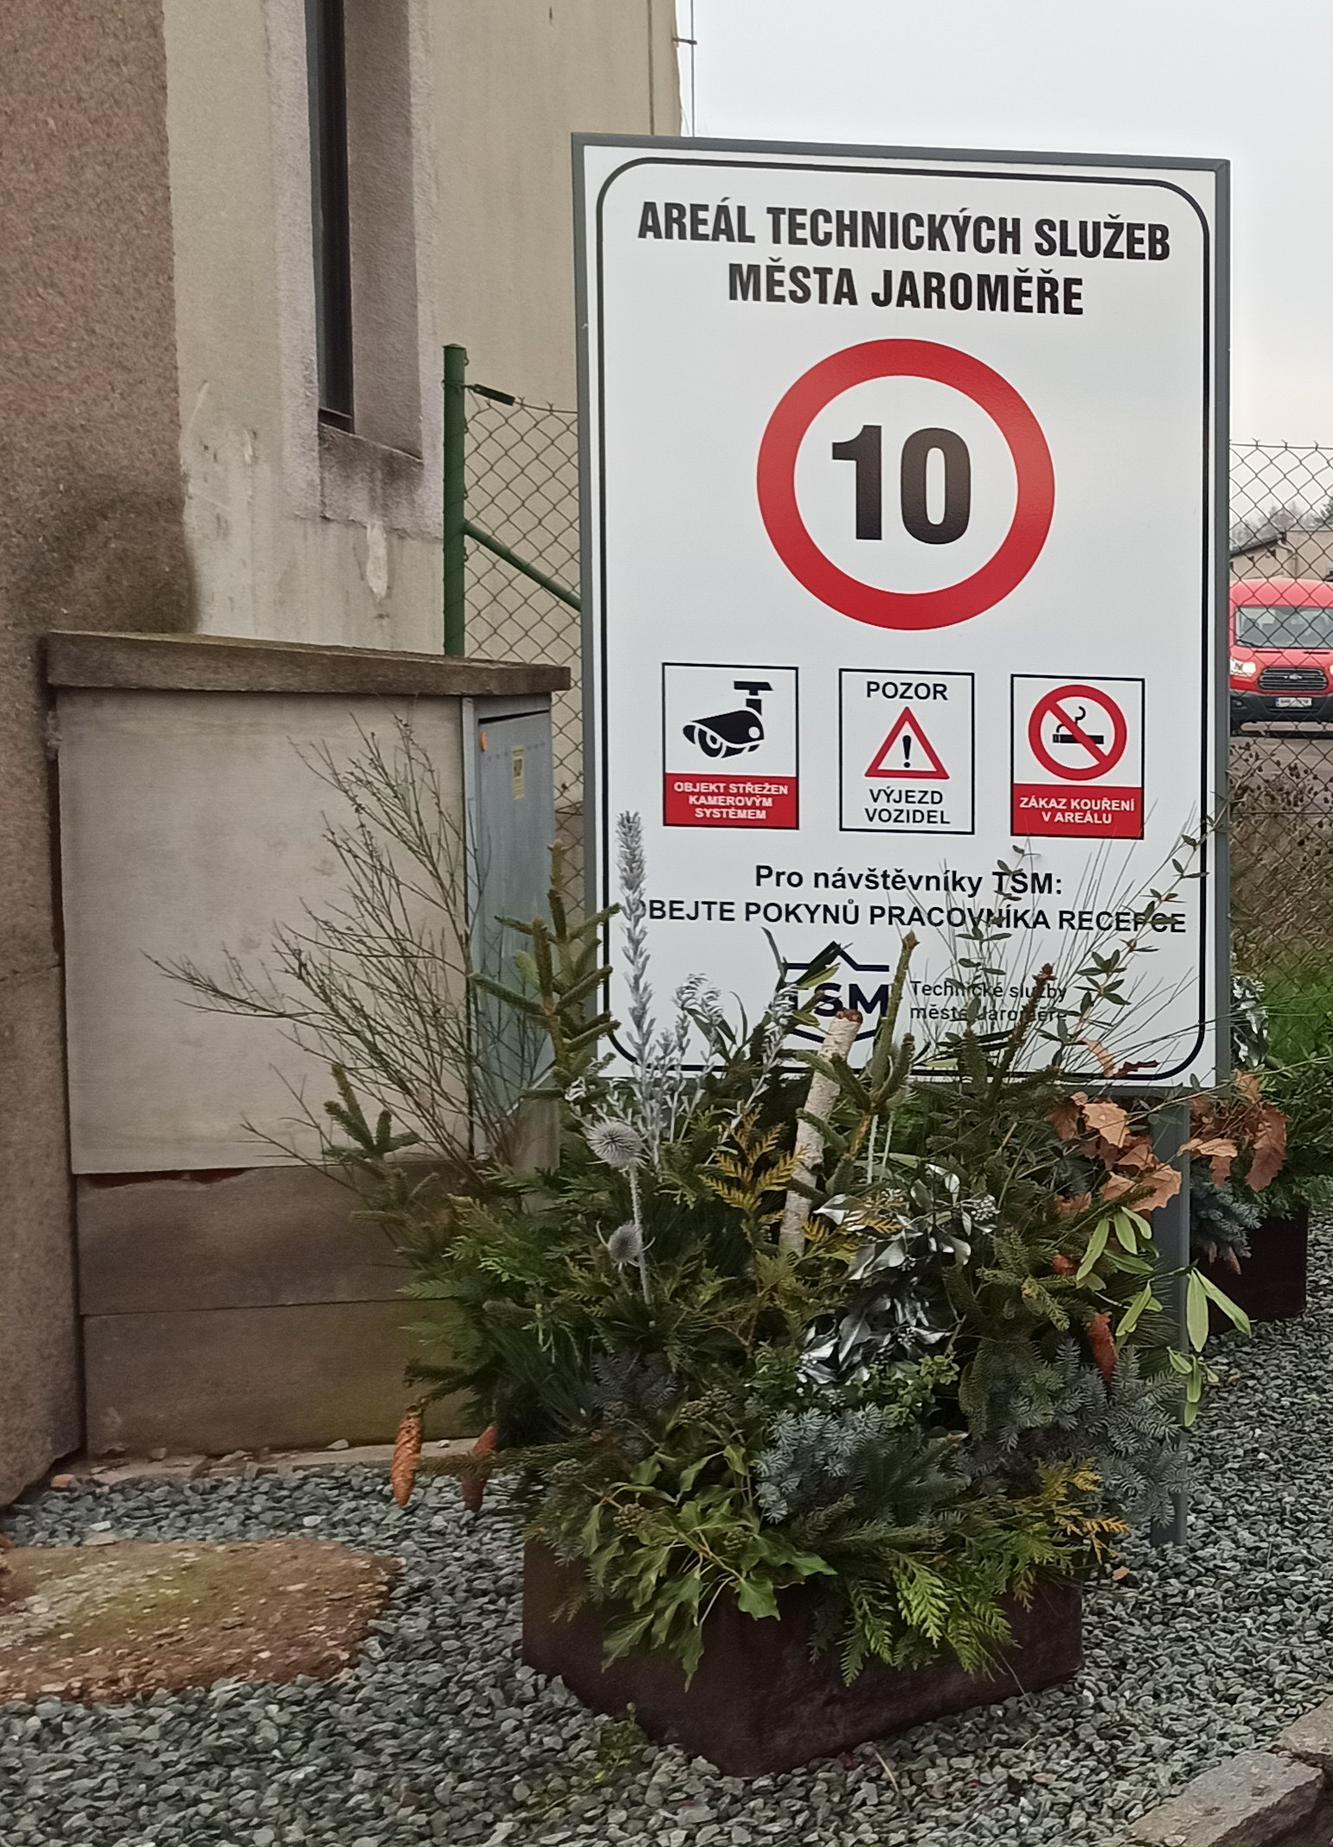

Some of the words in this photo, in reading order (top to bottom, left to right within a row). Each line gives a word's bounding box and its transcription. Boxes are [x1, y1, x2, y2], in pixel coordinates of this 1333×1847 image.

[637, 197, 756, 244] AREÁL
[766, 206, 1021, 255] TECHNICKÝCH
[1034, 213, 1171, 261] SLUŽEB
[728, 256, 858, 306] MĚSTA
[870, 267, 1084, 315] JAROMĚŘE
[831, 423, 972, 545] 10
[866, 680, 949, 701] POZOR
[673, 781, 727, 794] OBJEKT
[729, 781, 789, 796] STŘEŽEN
[869, 785, 944, 805] VÝJEZD
[688, 794, 773, 808] KAMEROVÝM
[1019, 795, 1067, 810] ZÁKAZ
[1070, 796, 1135, 812] KOUŘENÍ
[694, 807, 767, 820] SYSTÉMEM
[864, 807, 951, 825] VOZIDEL
[1041, 811, 1052, 823] V
[1054, 810, 1112, 825] AREÁLU
[755, 864, 804, 888] Pro
[813, 867, 983, 898] návštěvníky
[992, 871, 1062, 895] TSM:
[745, 898, 860, 925] POKYNŮ
[870, 904, 1051, 930] PRACOVNÍKA
[1058, 909, 1187, 933] RECEPCE
